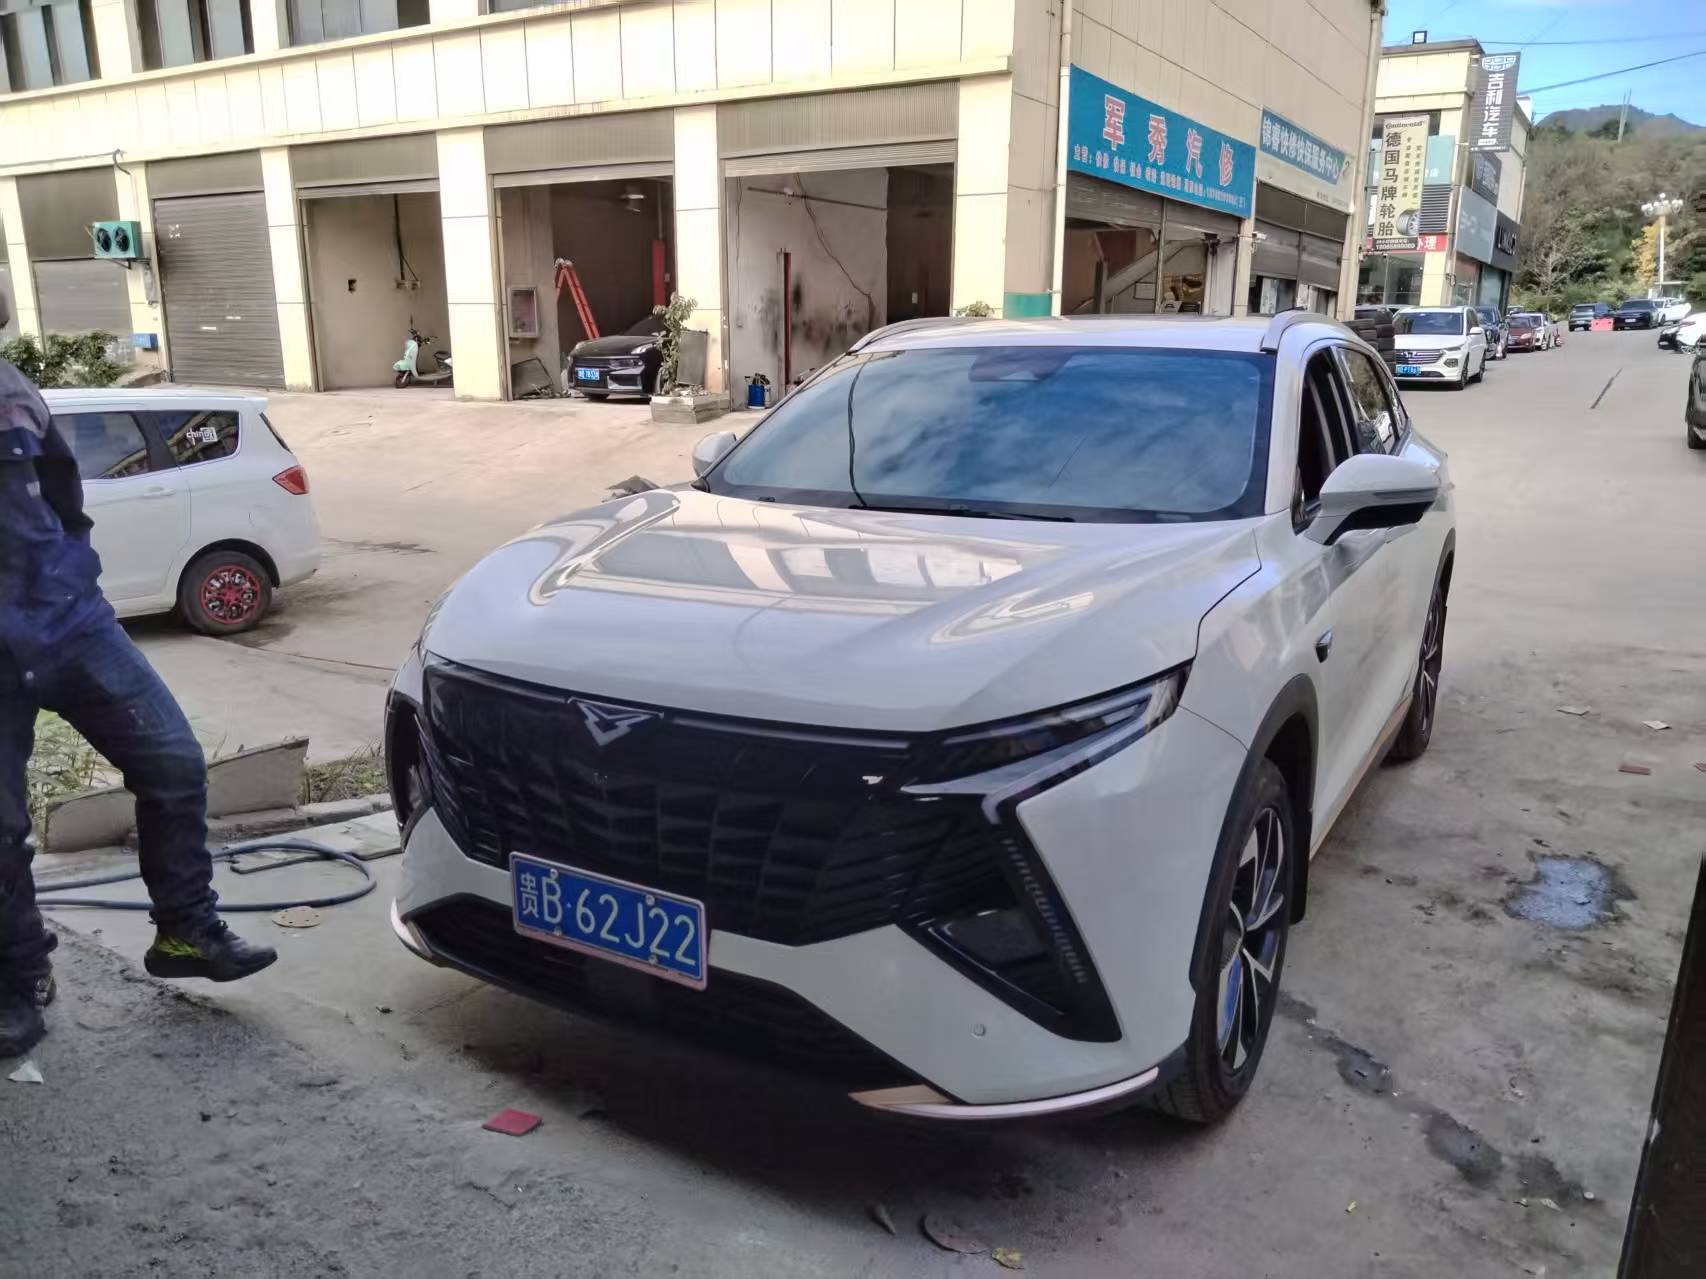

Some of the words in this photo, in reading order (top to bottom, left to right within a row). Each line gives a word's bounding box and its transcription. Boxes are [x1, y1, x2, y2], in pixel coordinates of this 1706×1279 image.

[1481, 73, 1504, 137] 吉利汽车
[1378, 131, 1402, 236] 德国马牌轮胎
